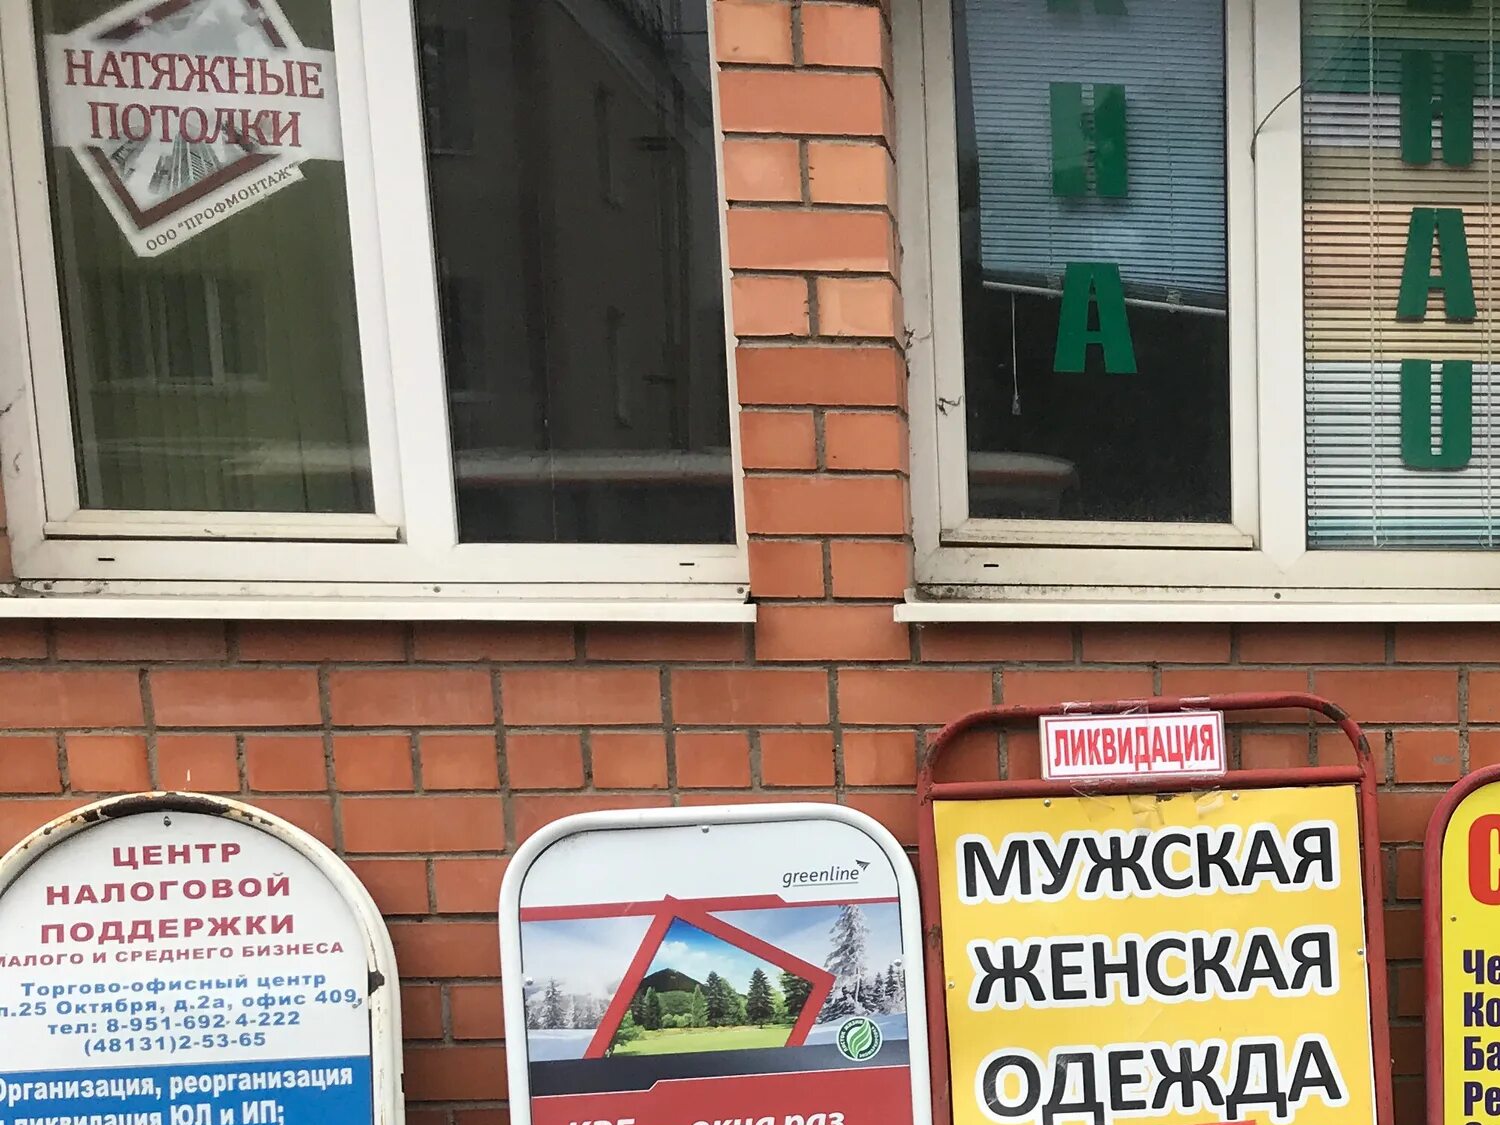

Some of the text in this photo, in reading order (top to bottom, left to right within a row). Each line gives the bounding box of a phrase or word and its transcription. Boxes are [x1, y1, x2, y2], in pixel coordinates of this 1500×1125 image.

[64, 48, 325, 99] НАТЯЖНЫЕ
[88, 101, 302, 147] ПОТОЛКИ
[146, 228, 178, 251] ООО
[1054, 723, 1216, 770] ЛИКВИДАЦИЯ
[112, 842, 241, 868] ЦЕНТР
[963, 826, 1334, 898] МУЖСКАЯ
[46, 872, 291, 906] НАЛОГОВОЙ
[782, 866, 860, 888] greenline
[40, 914, 294, 945] ПОДДЕРЖКИ
[92, 952, 106, 964] И
[115, 946, 234, 963] СРЕДНЕГО
[242, 941, 344, 958] БИЗНЕСА
[973, 931, 1333, 1004] ЖЕНСКАЯ
[21, 972, 326, 999] Торгово-офисный центр
[56, 997, 166, 1015] Октября,
[242, 992, 306, 1011] офис
[48, 1011, 301, 1036] тел: 8-951-692-4-222
[84, 1032, 266, 1057] (48131)2-53-65
[169, 1066, 353, 1098] реорганизация
[220, 1107, 234, 1125] и
[242, 1099, 285, 1125] ИП;
